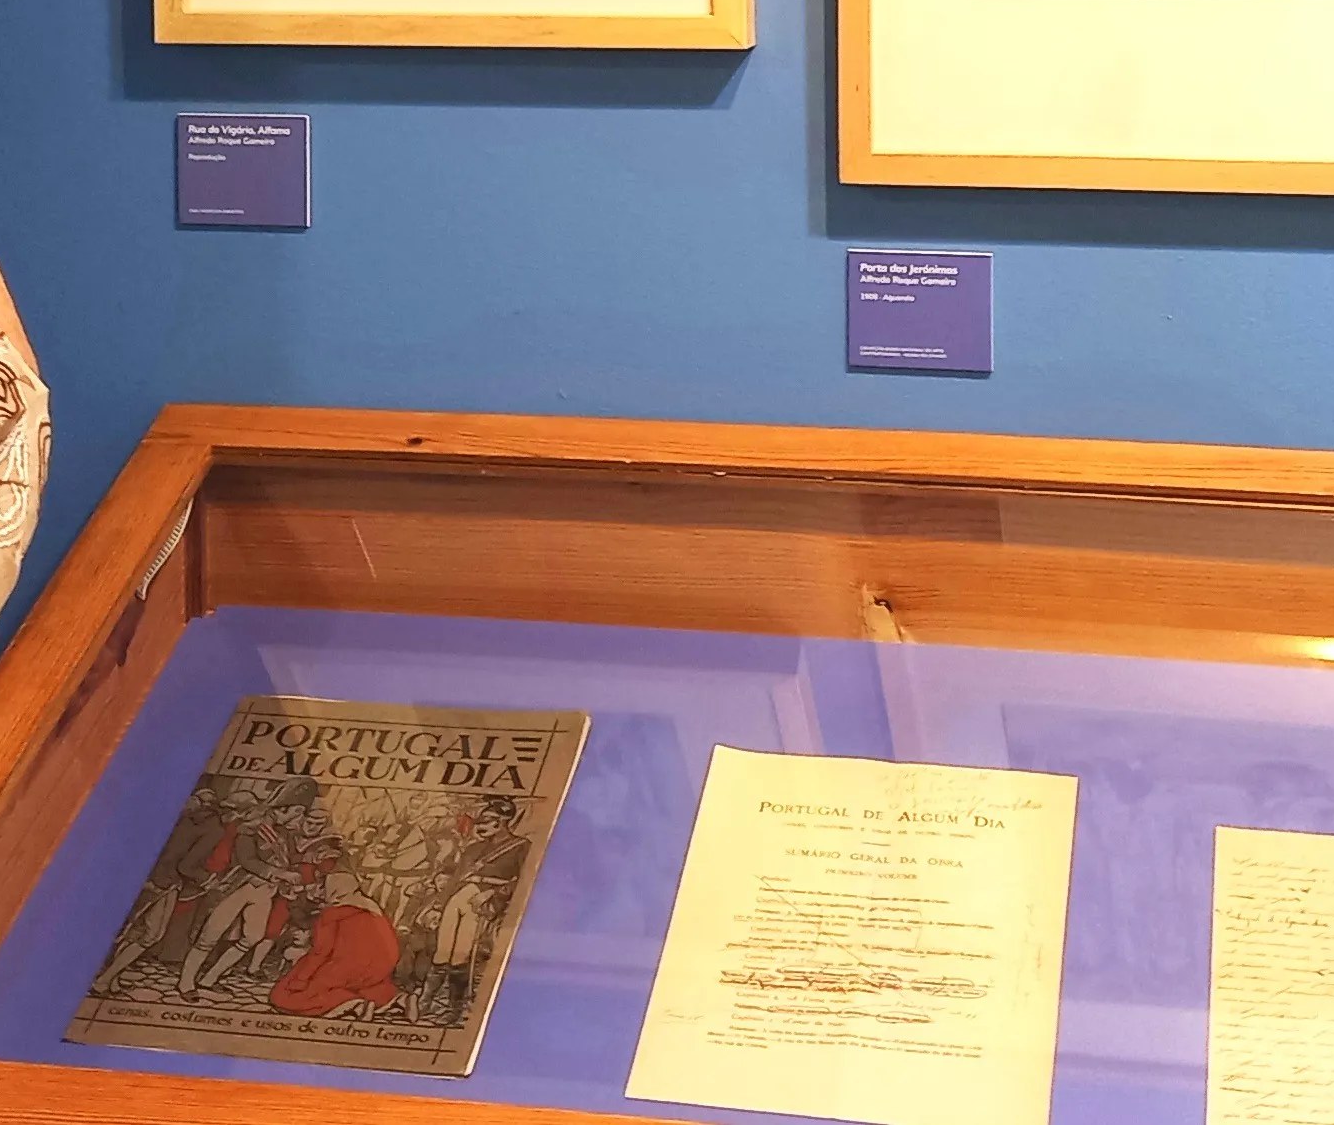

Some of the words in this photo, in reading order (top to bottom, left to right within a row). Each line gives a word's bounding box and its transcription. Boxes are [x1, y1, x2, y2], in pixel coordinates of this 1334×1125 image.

[188, 125, 207, 134] Rua
[889, 264, 908, 274] dos
[240, 720, 506, 761] PORTUGAL
[227, 755, 267, 772] DE
[267, 751, 433, 784] ALGUM
[440, 760, 526, 791] DIA
[863, 809, 885, 822] DE
[899, 856, 918, 865] DA
